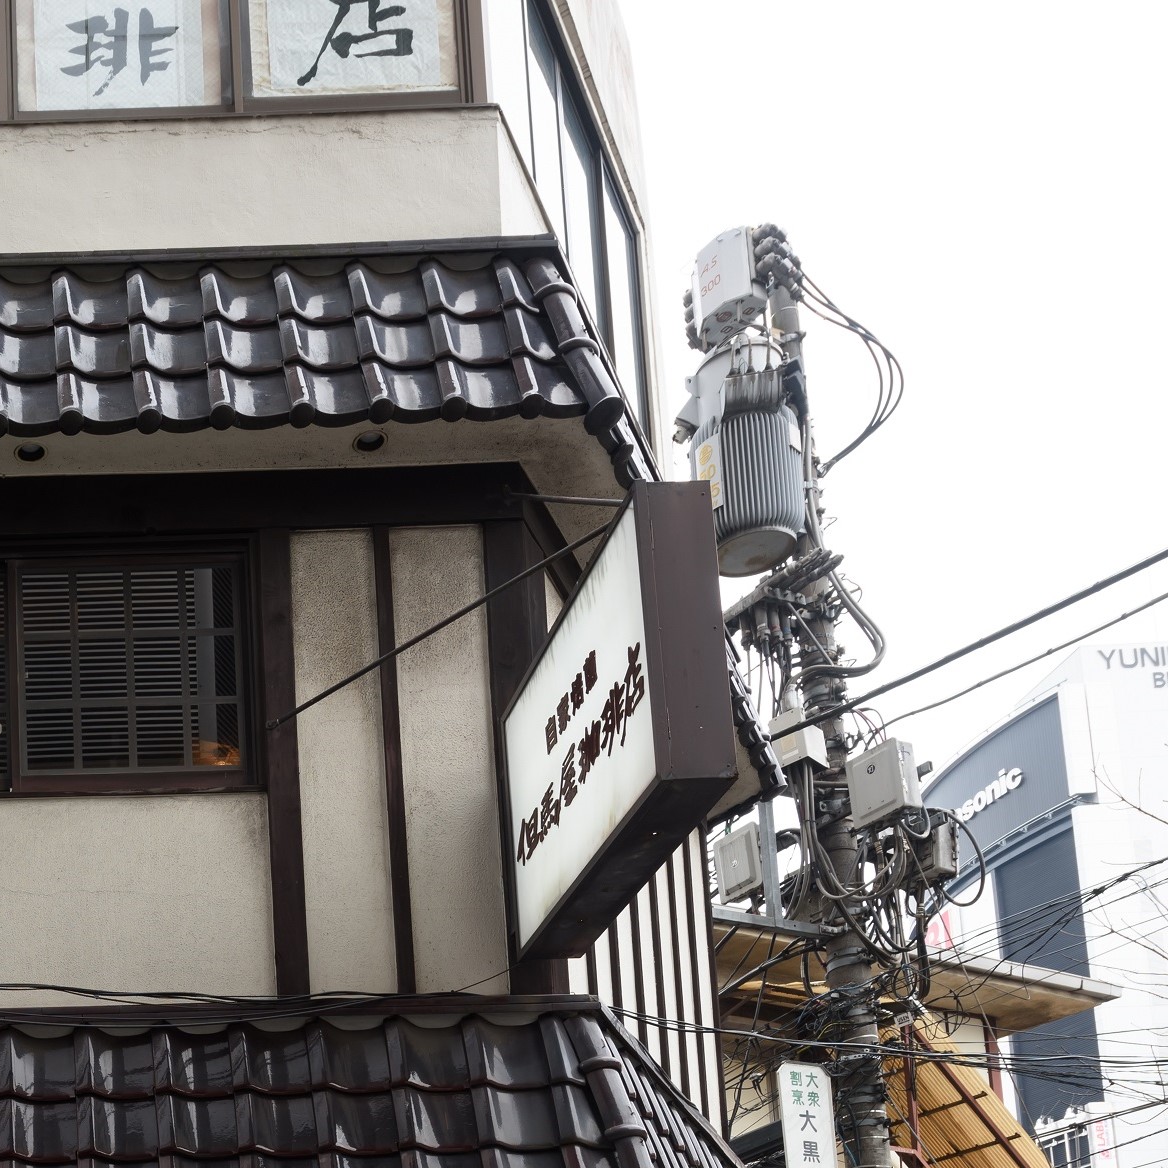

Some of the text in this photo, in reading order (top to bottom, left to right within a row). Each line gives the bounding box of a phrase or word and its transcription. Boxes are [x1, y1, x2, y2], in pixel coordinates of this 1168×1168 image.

[1098, 646, 1168, 670] YUNI
[1153, 672, 1168, 689] B
[517, 642, 645, 866] 但馬屋珈琲店
[956, 767, 1023, 826] sonic
[790, 1071, 804, 1106] 割烹
[805, 1072, 820, 1107] 大衆
